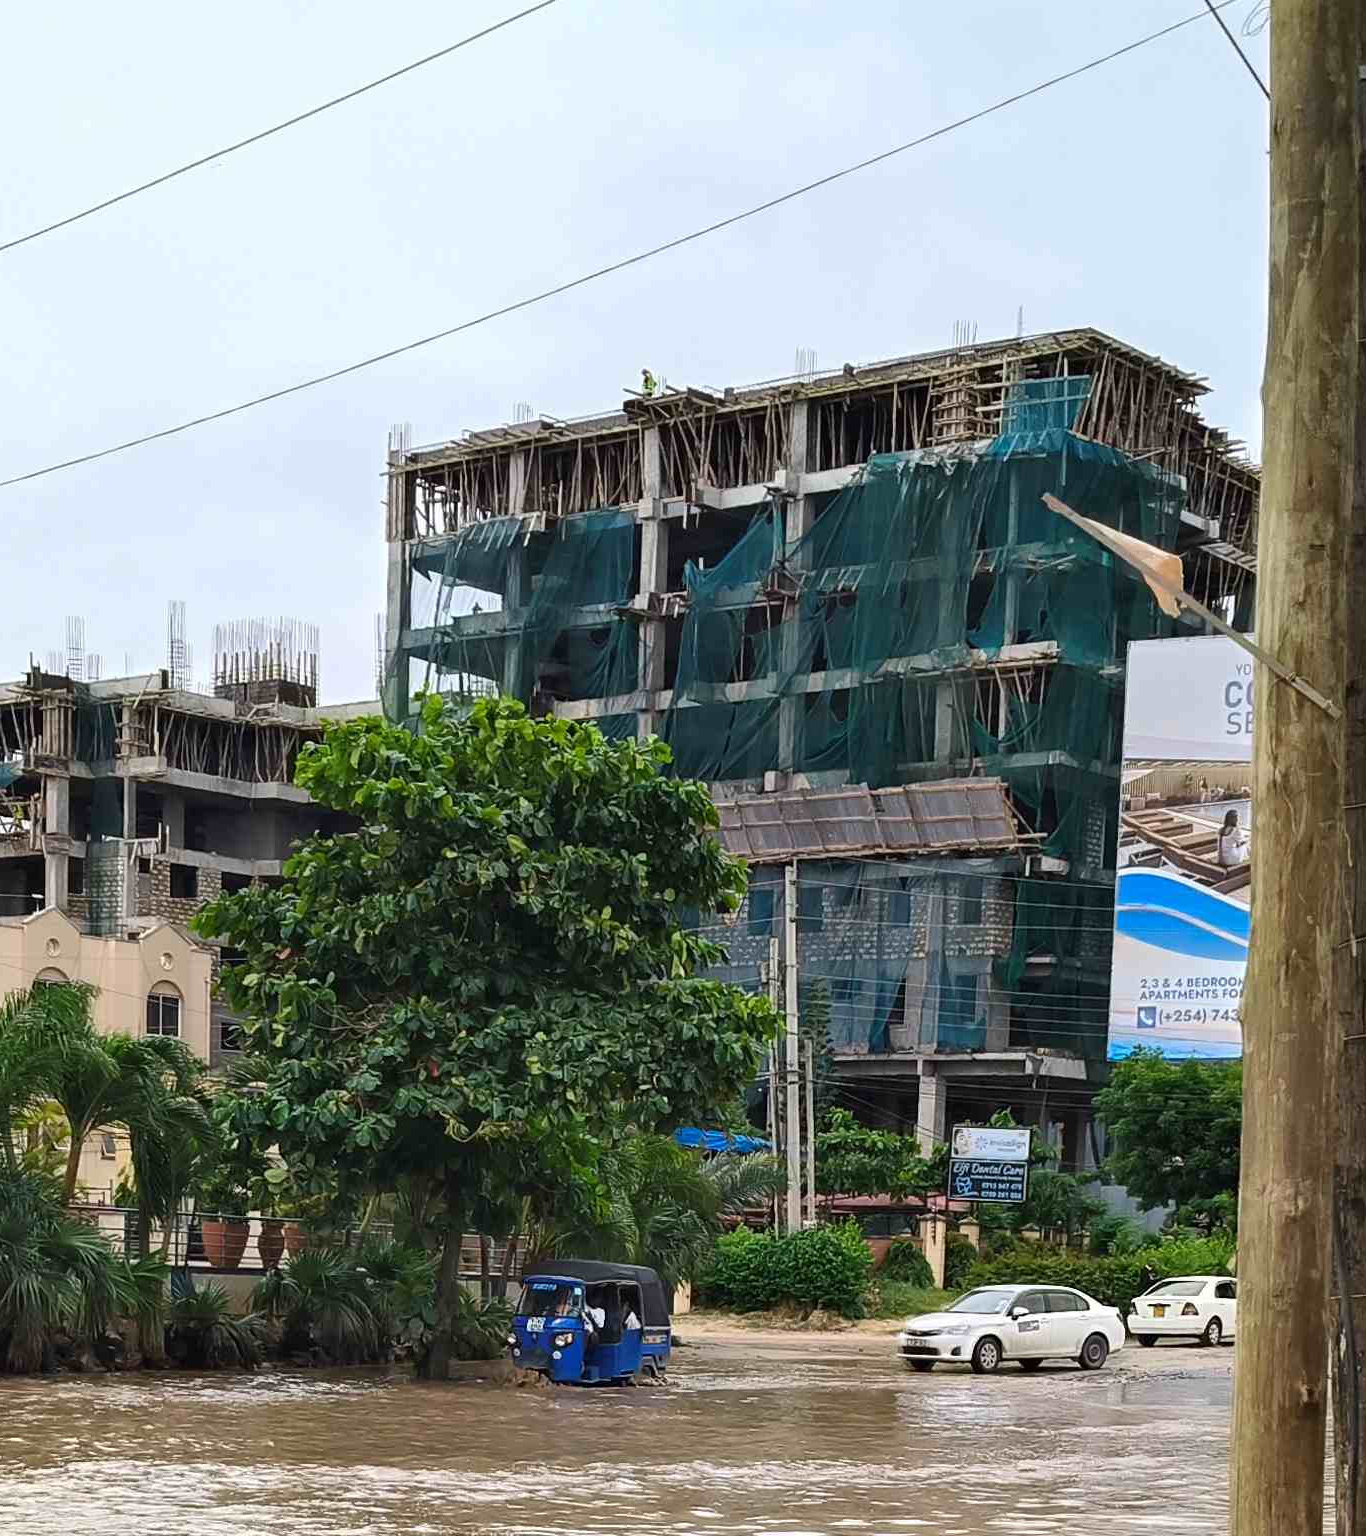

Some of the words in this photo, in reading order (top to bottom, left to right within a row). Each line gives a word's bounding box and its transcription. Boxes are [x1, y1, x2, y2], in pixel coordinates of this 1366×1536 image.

[1139, 989, 1219, 1001] APARTMENTS
[1159, 1008, 1207, 1024] (+254)
[971, 1163, 1003, 1175] Dental
